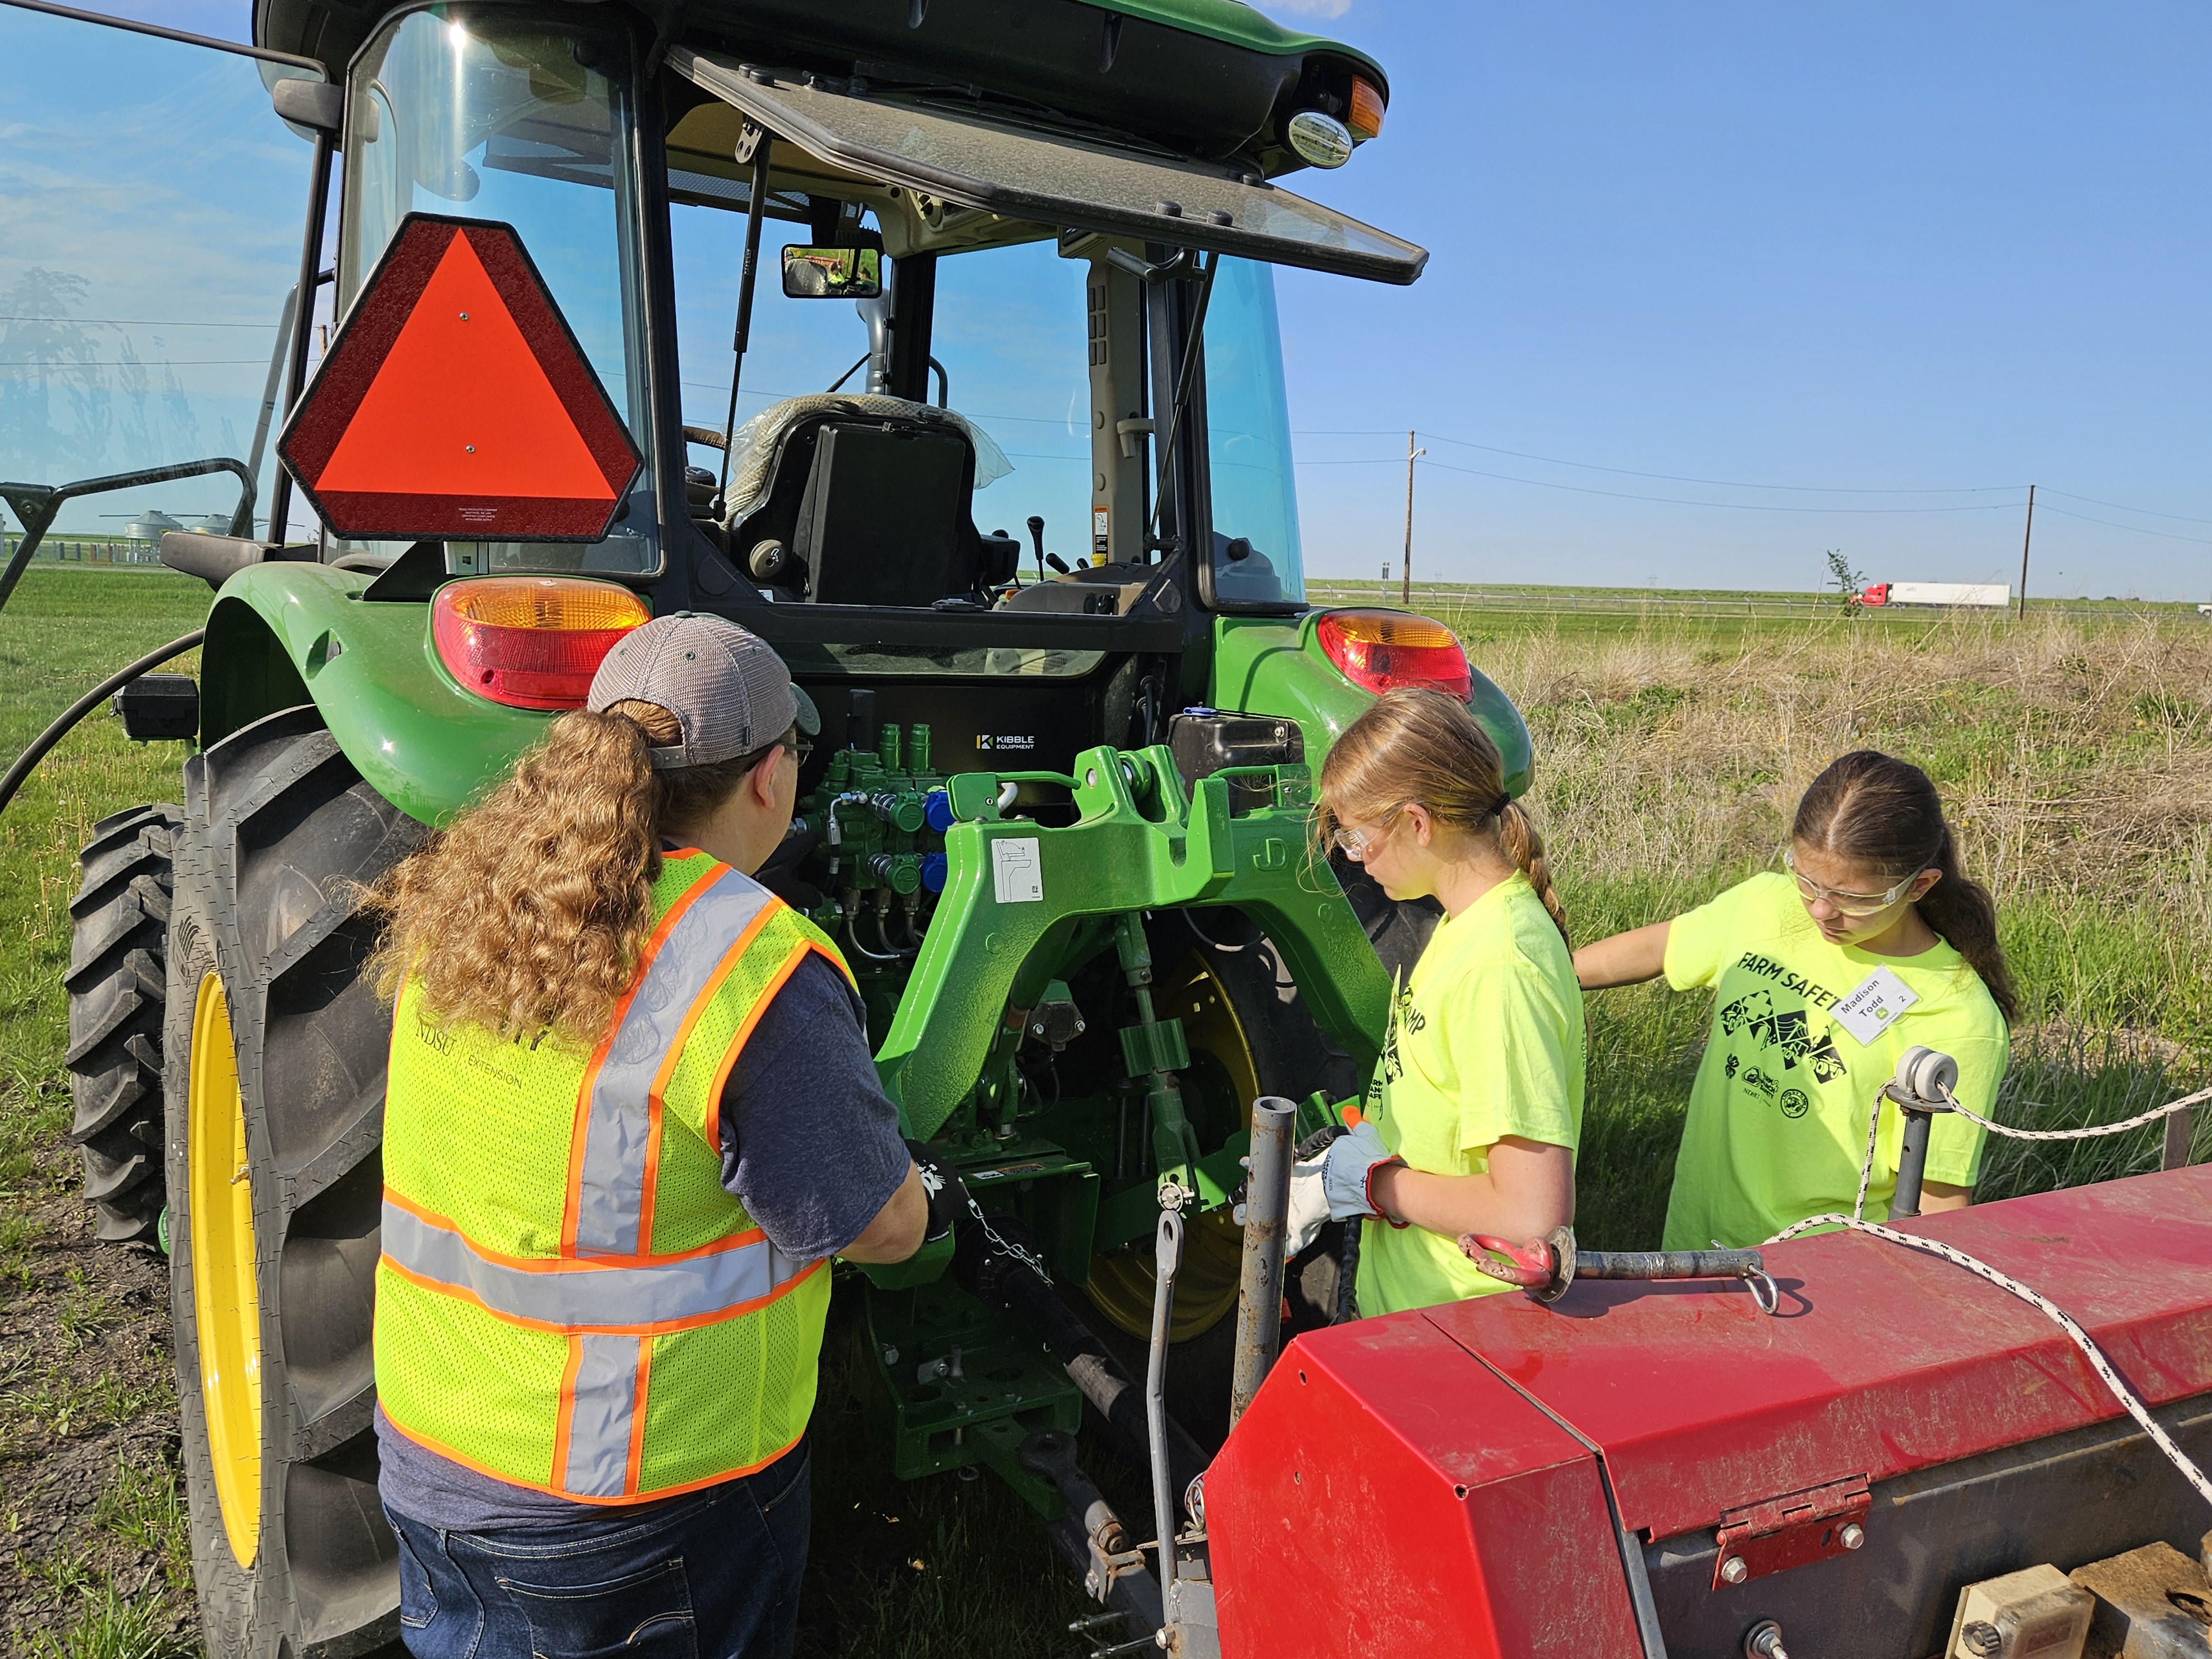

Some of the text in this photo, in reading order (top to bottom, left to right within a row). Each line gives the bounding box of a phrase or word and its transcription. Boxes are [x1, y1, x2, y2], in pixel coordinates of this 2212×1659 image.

[1737, 951, 1842, 1011] FARM SAFET
[1840, 980, 1880, 1014] Madison
[1405, 1006, 1426, 1035] MP
[1858, 995, 1884, 1017] Todd
[416, 1023, 524, 1089] NDSU EXTENSION
